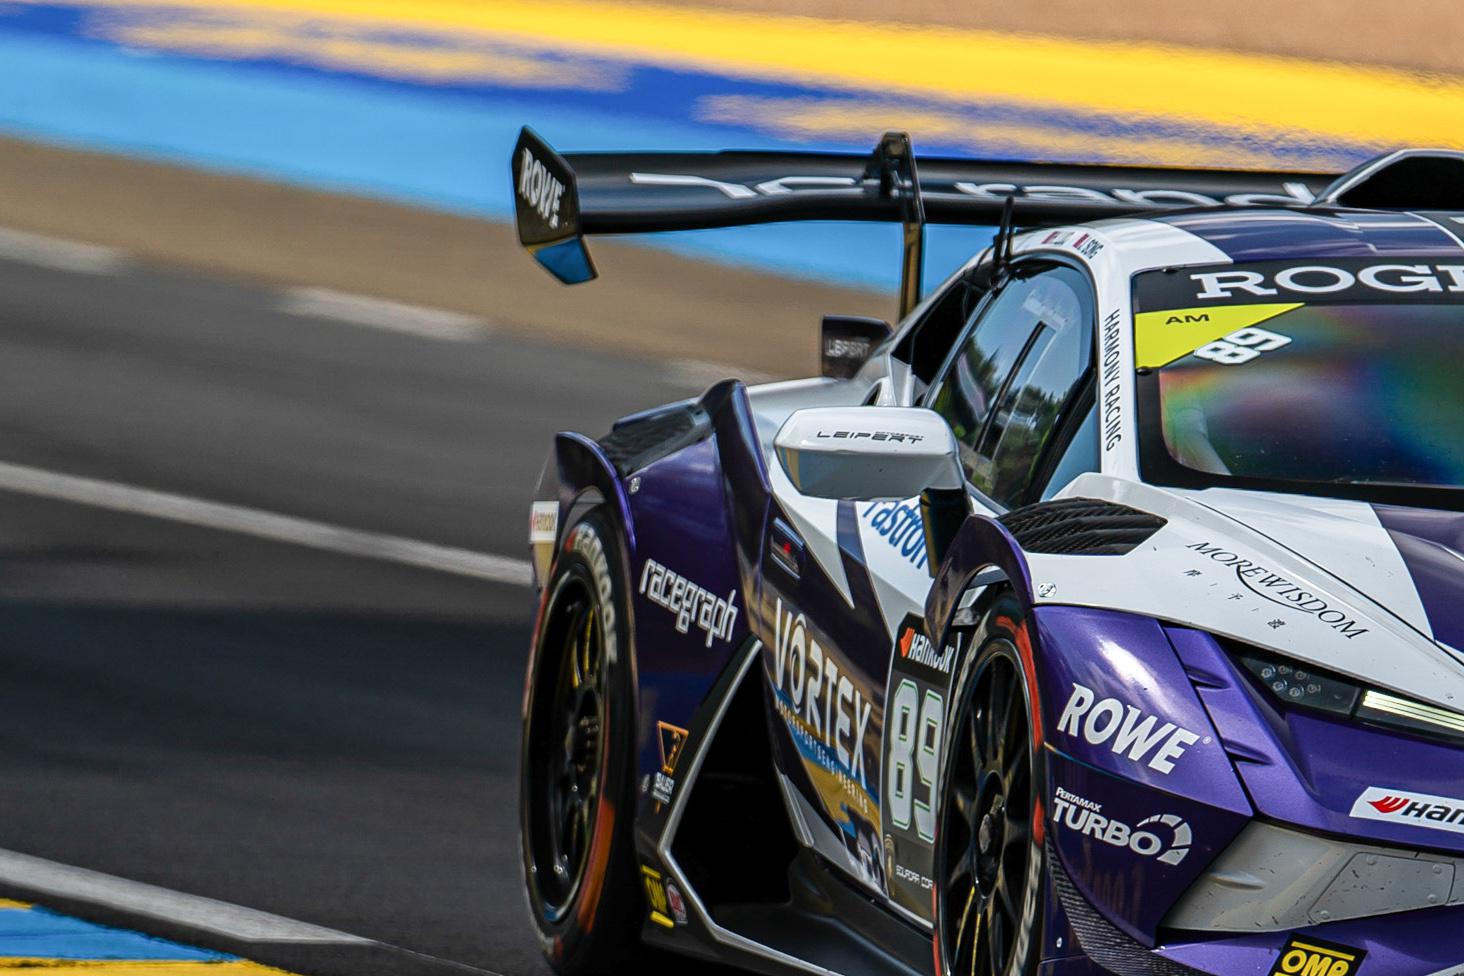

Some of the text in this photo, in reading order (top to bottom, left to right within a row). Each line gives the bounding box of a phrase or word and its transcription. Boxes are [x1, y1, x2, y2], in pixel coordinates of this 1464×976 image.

[518, 147, 566, 229] ROWE
[1165, 313, 1211, 326] AM
[1193, 327, 1293, 365] 89
[1104, 308, 1122, 453] HARMONY RACING
[816, 430, 925, 445] LEIPERT
[639, 558, 739, 648] racegraph
[1185, 541, 1370, 640] MOREWISDOM
[888, 678, 944, 845] 89
[1057, 682, 1200, 775] ROWE
[1053, 797, 1162, 855] TURBO
[1056, 786, 1102, 813] PERTAMAX
